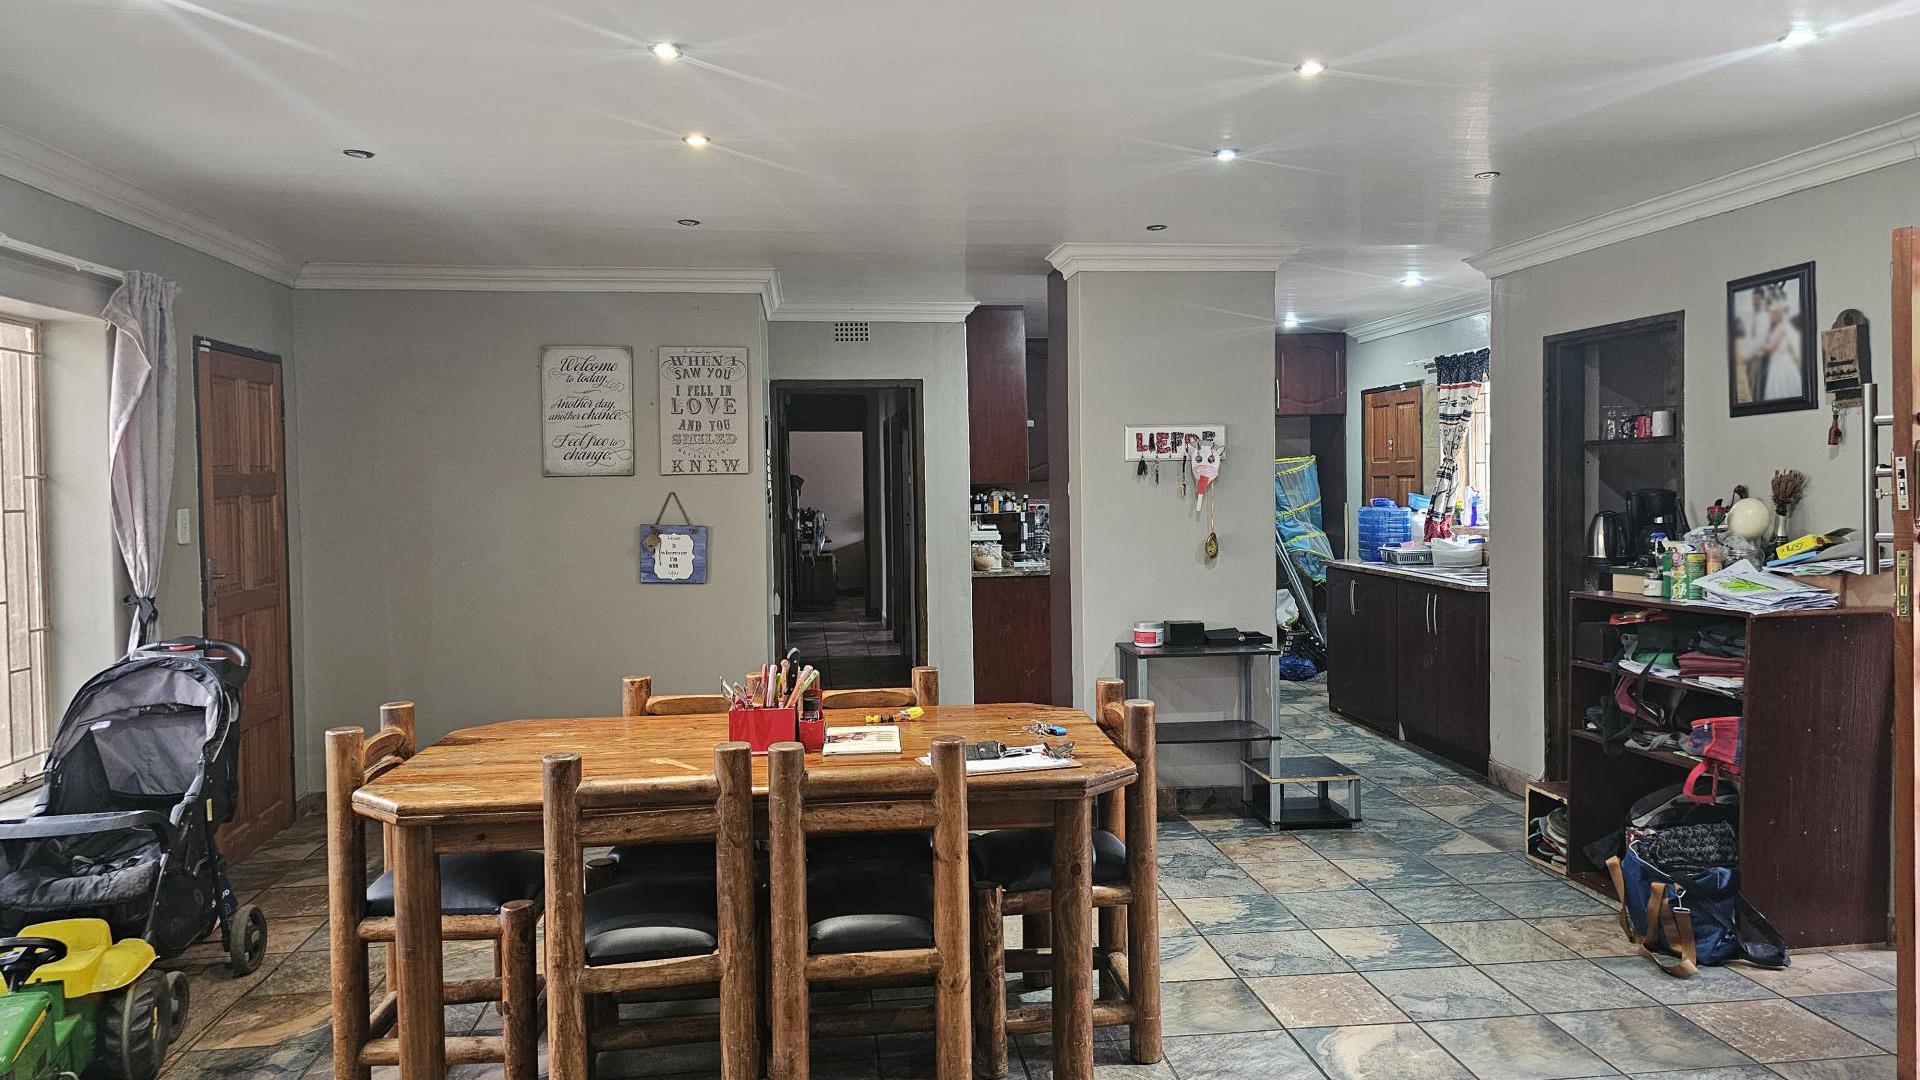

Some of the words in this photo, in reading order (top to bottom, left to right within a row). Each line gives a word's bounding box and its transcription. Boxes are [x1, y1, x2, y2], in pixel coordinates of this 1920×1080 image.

[560, 356, 617, 371] Welcome
[670, 355, 723, 367] WHEN
[731, 355, 738, 367] I
[566, 374, 574, 383] to
[674, 367, 701, 380] SAW
[707, 367, 732, 380] YOU
[675, 384, 681, 397] I
[687, 384, 714, 397] FELL
[719, 384, 732, 397] IN
[551, 396, 593, 409] Another
[670, 397, 737, 415] LOVE
[548, 411, 580, 421] another
[678, 419, 702, 432] AND
[708, 419, 731, 432] YOU
[557, 432, 587, 448] Feel
[582, 435, 609, 449] free
[610, 439, 618, 447] to
[671, 433, 738, 445] SMILED
[671, 459, 741, 473] KNEW
